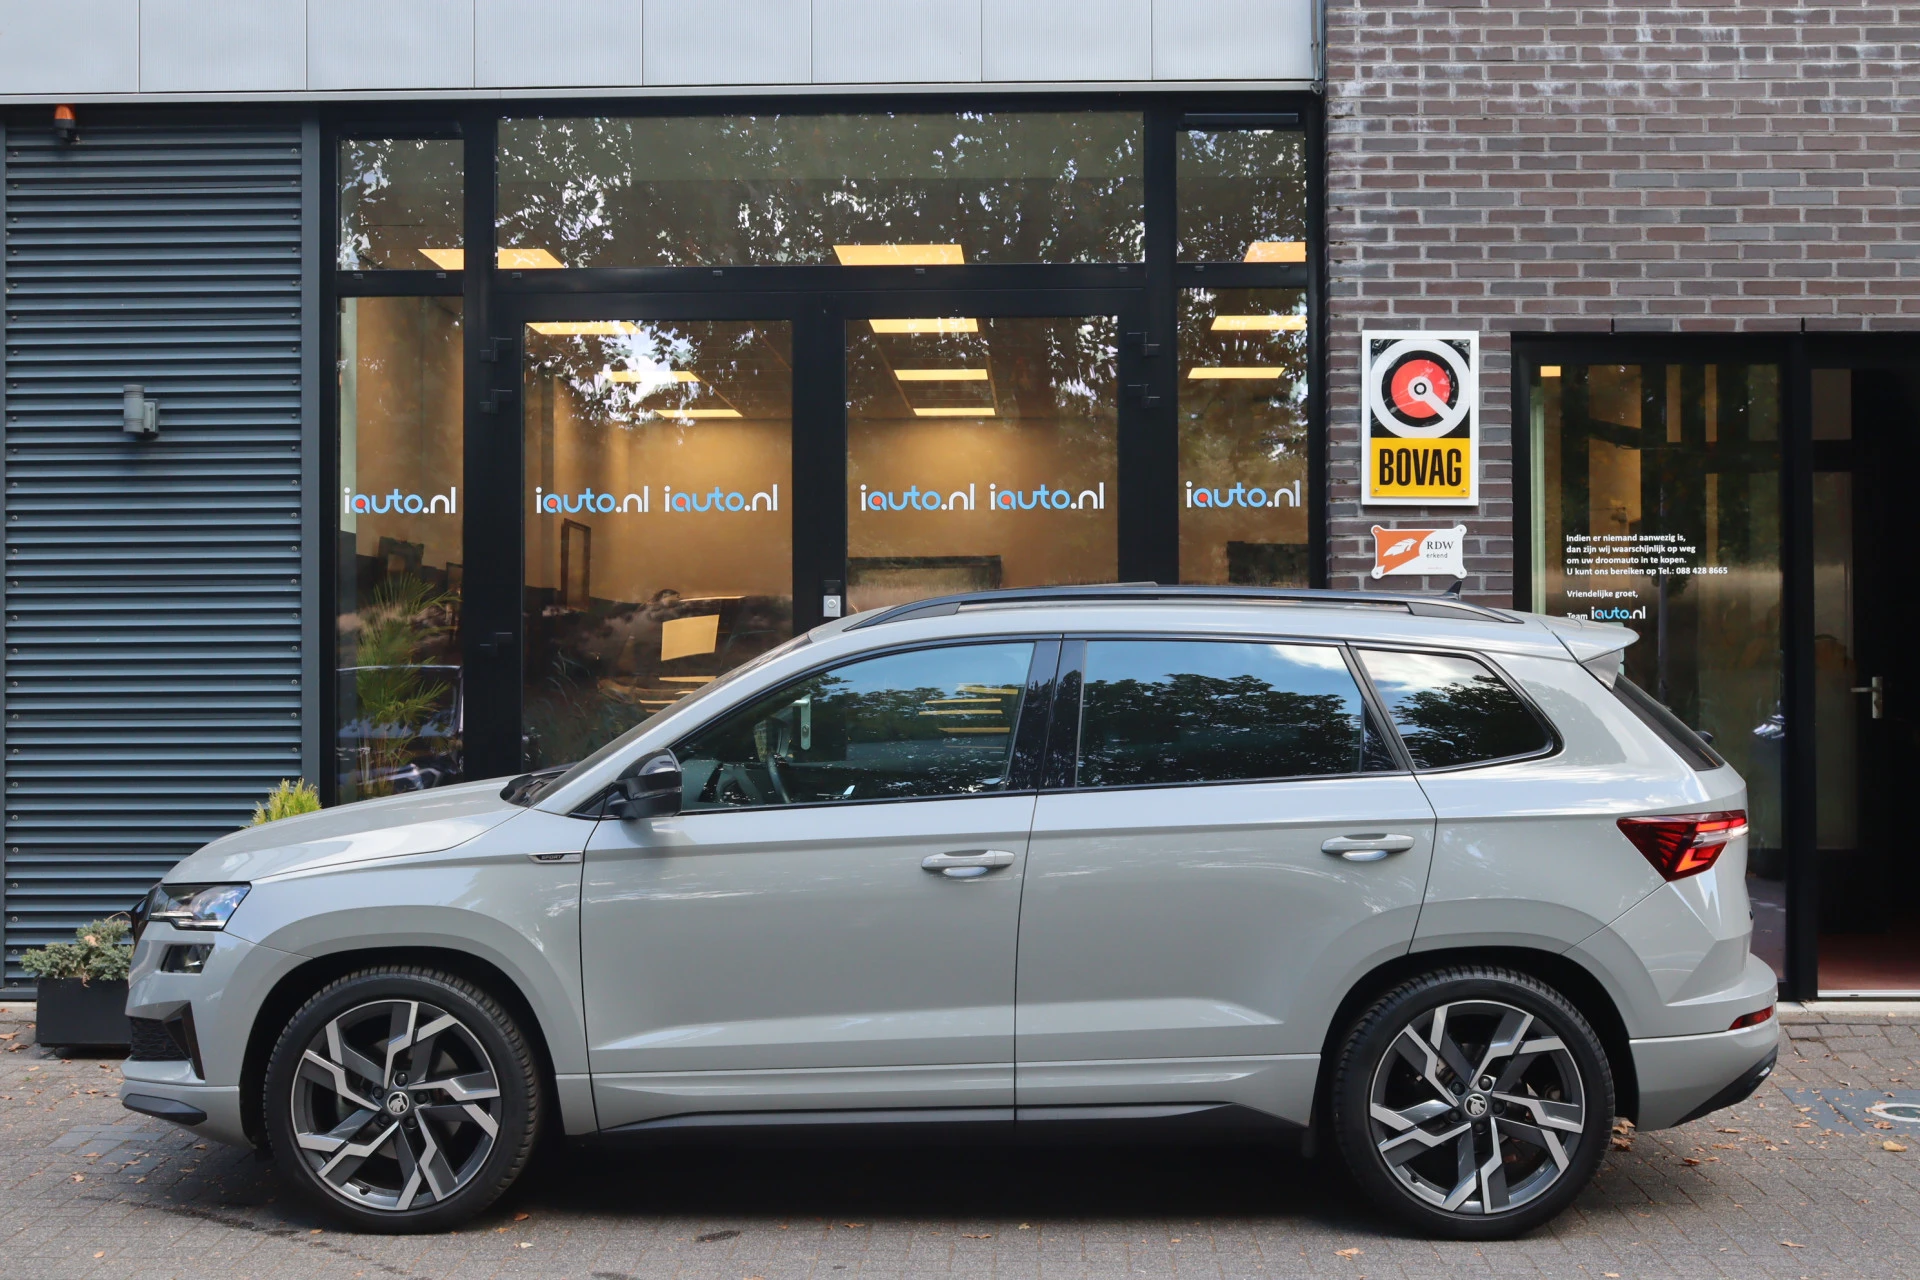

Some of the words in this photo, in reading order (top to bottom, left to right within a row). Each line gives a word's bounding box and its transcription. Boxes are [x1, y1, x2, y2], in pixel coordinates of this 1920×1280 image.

[1379, 448, 1462, 487] BOVAG
[535, 485, 649, 513] iauto.nl
[664, 484, 778, 512] iauto.nl
[860, 483, 975, 511] iauto.nl
[989, 482, 1104, 510] iauto.nl
[1185, 480, 1301, 508] iauto.nl
[343, 486, 456, 514] iauto.nl
[1639, 535, 1675, 543] aanwezig
[1677, 534, 1686, 542] is,
[1426, 541, 1454, 550] RDW
[1566, 545, 1581, 553] dan
[1583, 546, 1596, 554] zijn
[1598, 546, 1611, 554] wij
[1612, 545, 1665, 554] waarschijnlijk
[1595, 556, 1639, 564] droomauto
[1660, 556, 1687, 565] kopen.
[1575, 567, 1592, 575] kunt
[1610, 567, 1644, 575] bereiken
[1658, 567, 1674, 575] Tel.:
[1567, 590, 1613, 599] Vriendelijke
[1615, 591, 1638, 599] groet,
[1567, 612, 1588, 620] Team
[1591, 606, 1646, 619] iauto.nl
